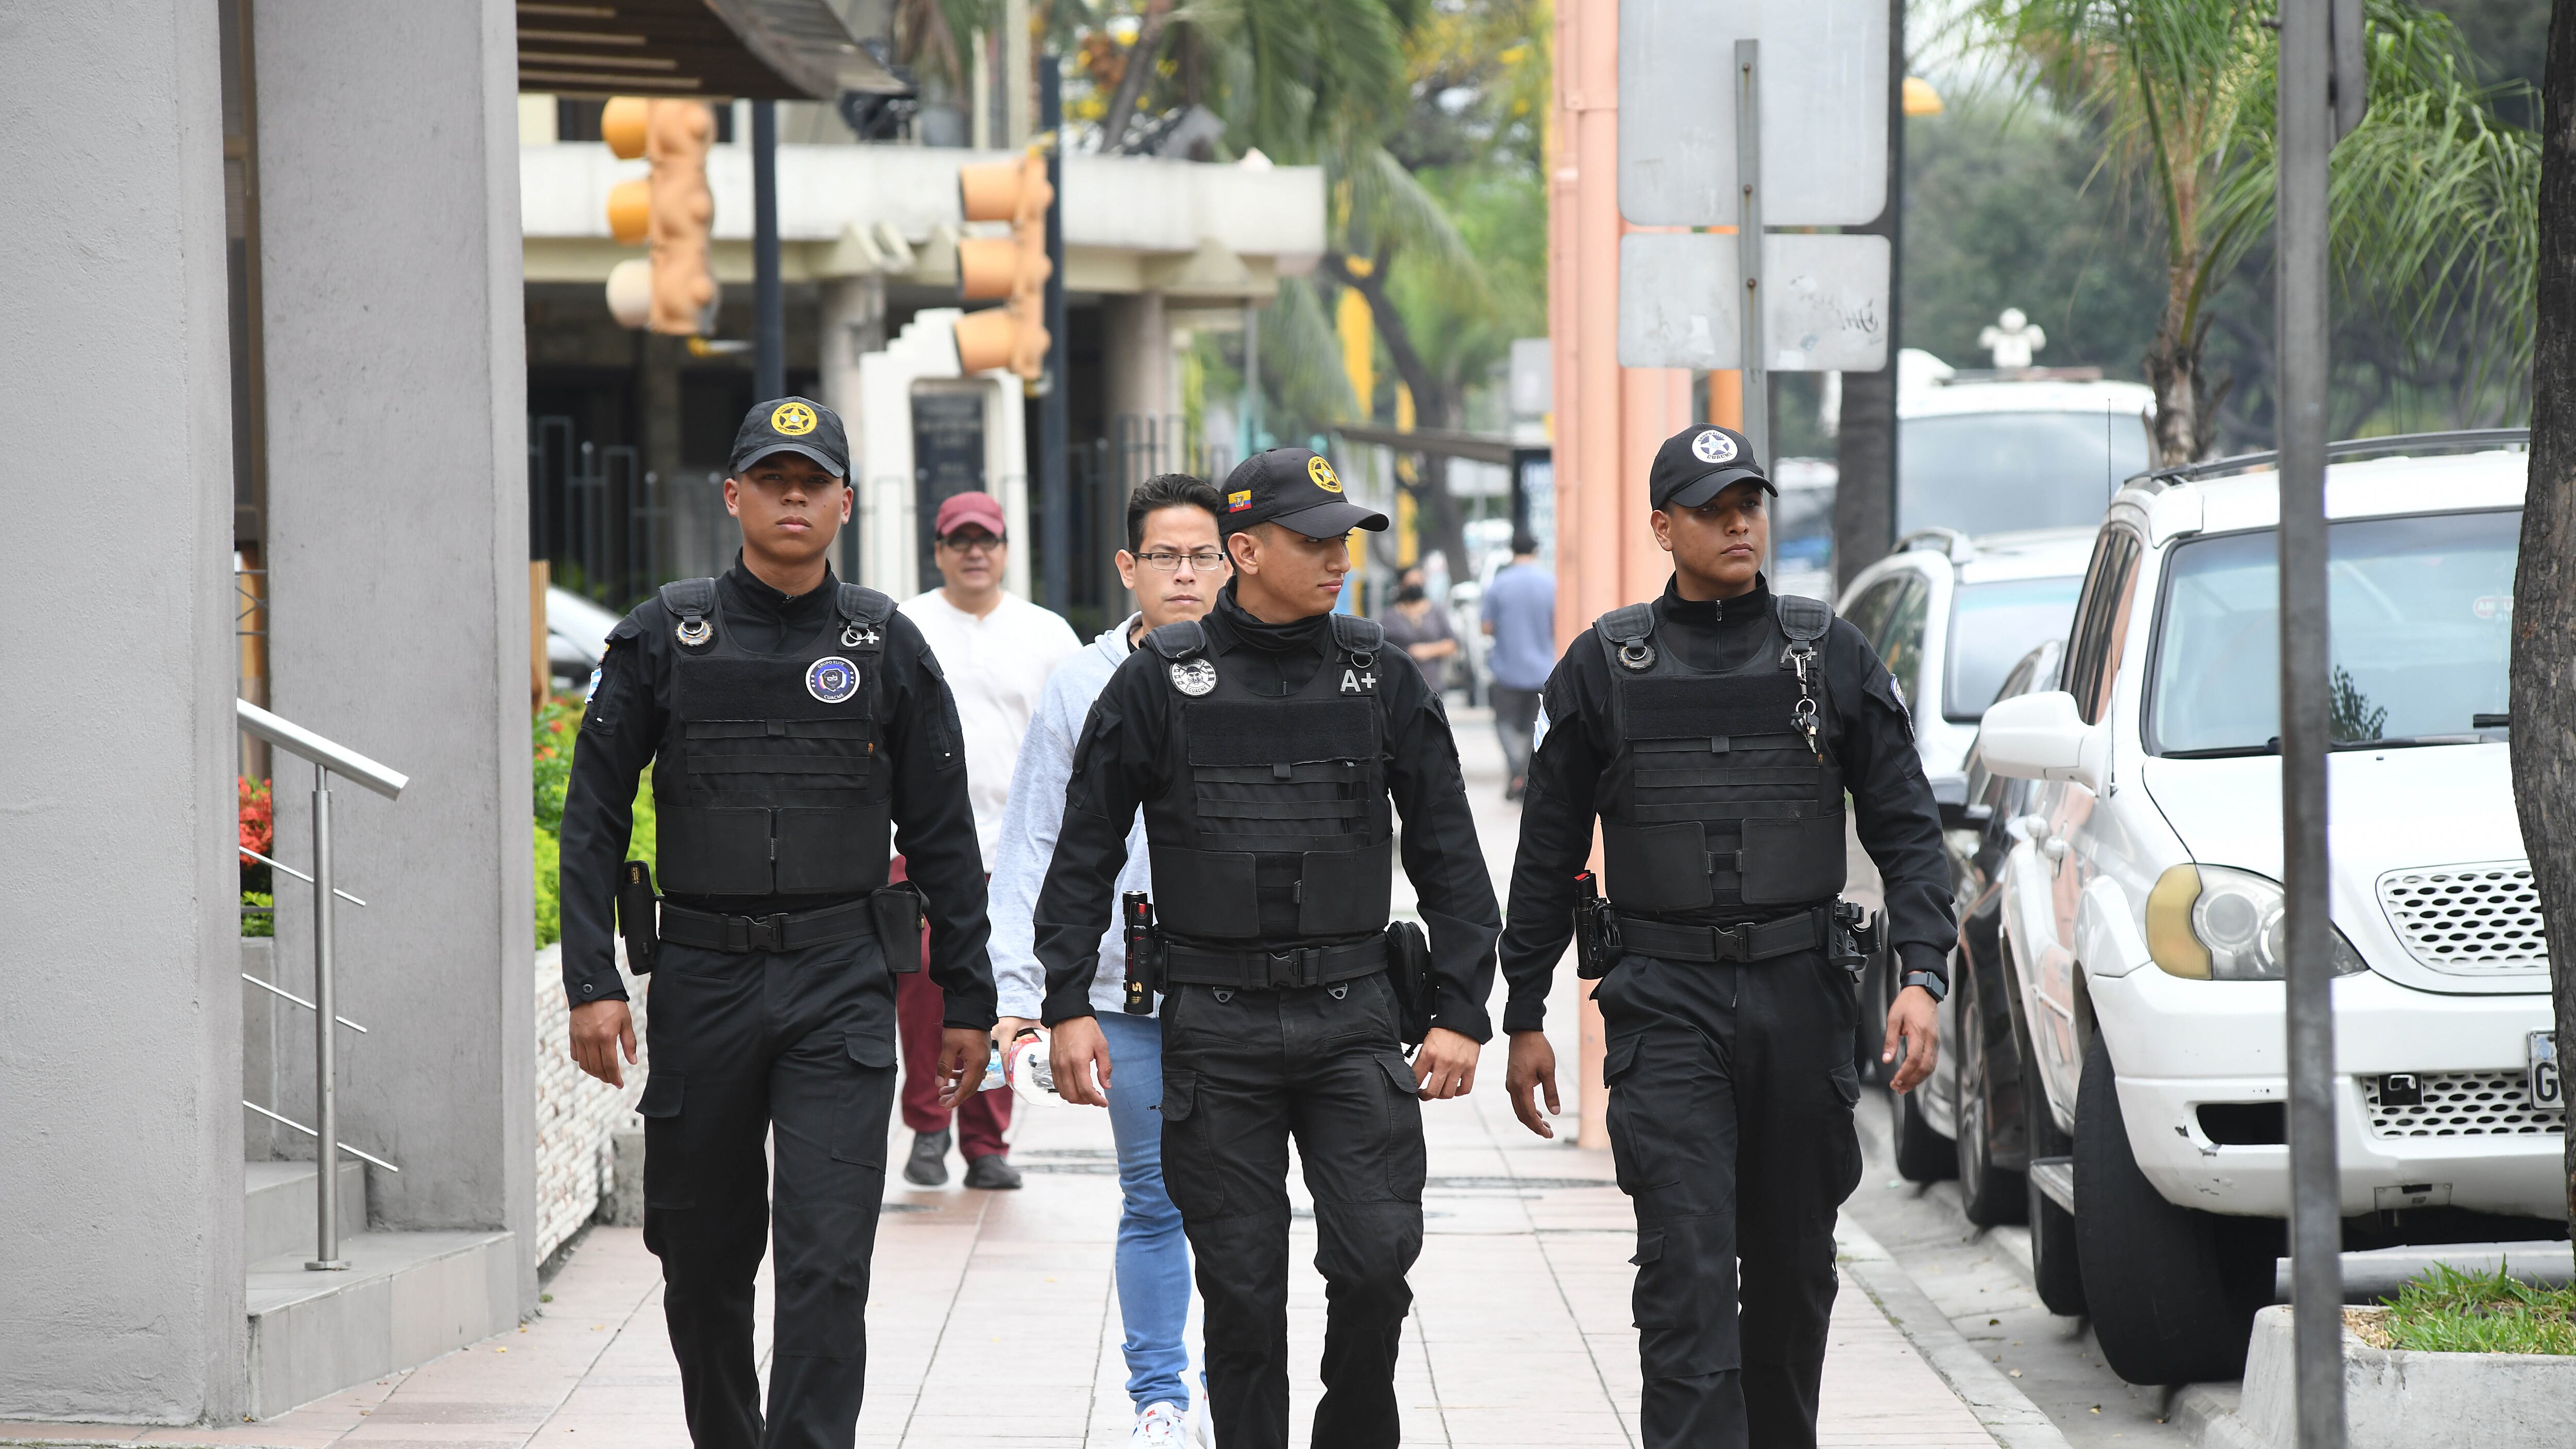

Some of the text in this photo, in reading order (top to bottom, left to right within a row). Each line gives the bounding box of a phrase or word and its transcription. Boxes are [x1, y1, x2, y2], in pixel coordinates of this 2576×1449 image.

[1698, 432, 1712, 442] GRUPO
[817, 660, 833, 669] GRUPO
[1340, 669, 1377, 692] A+
